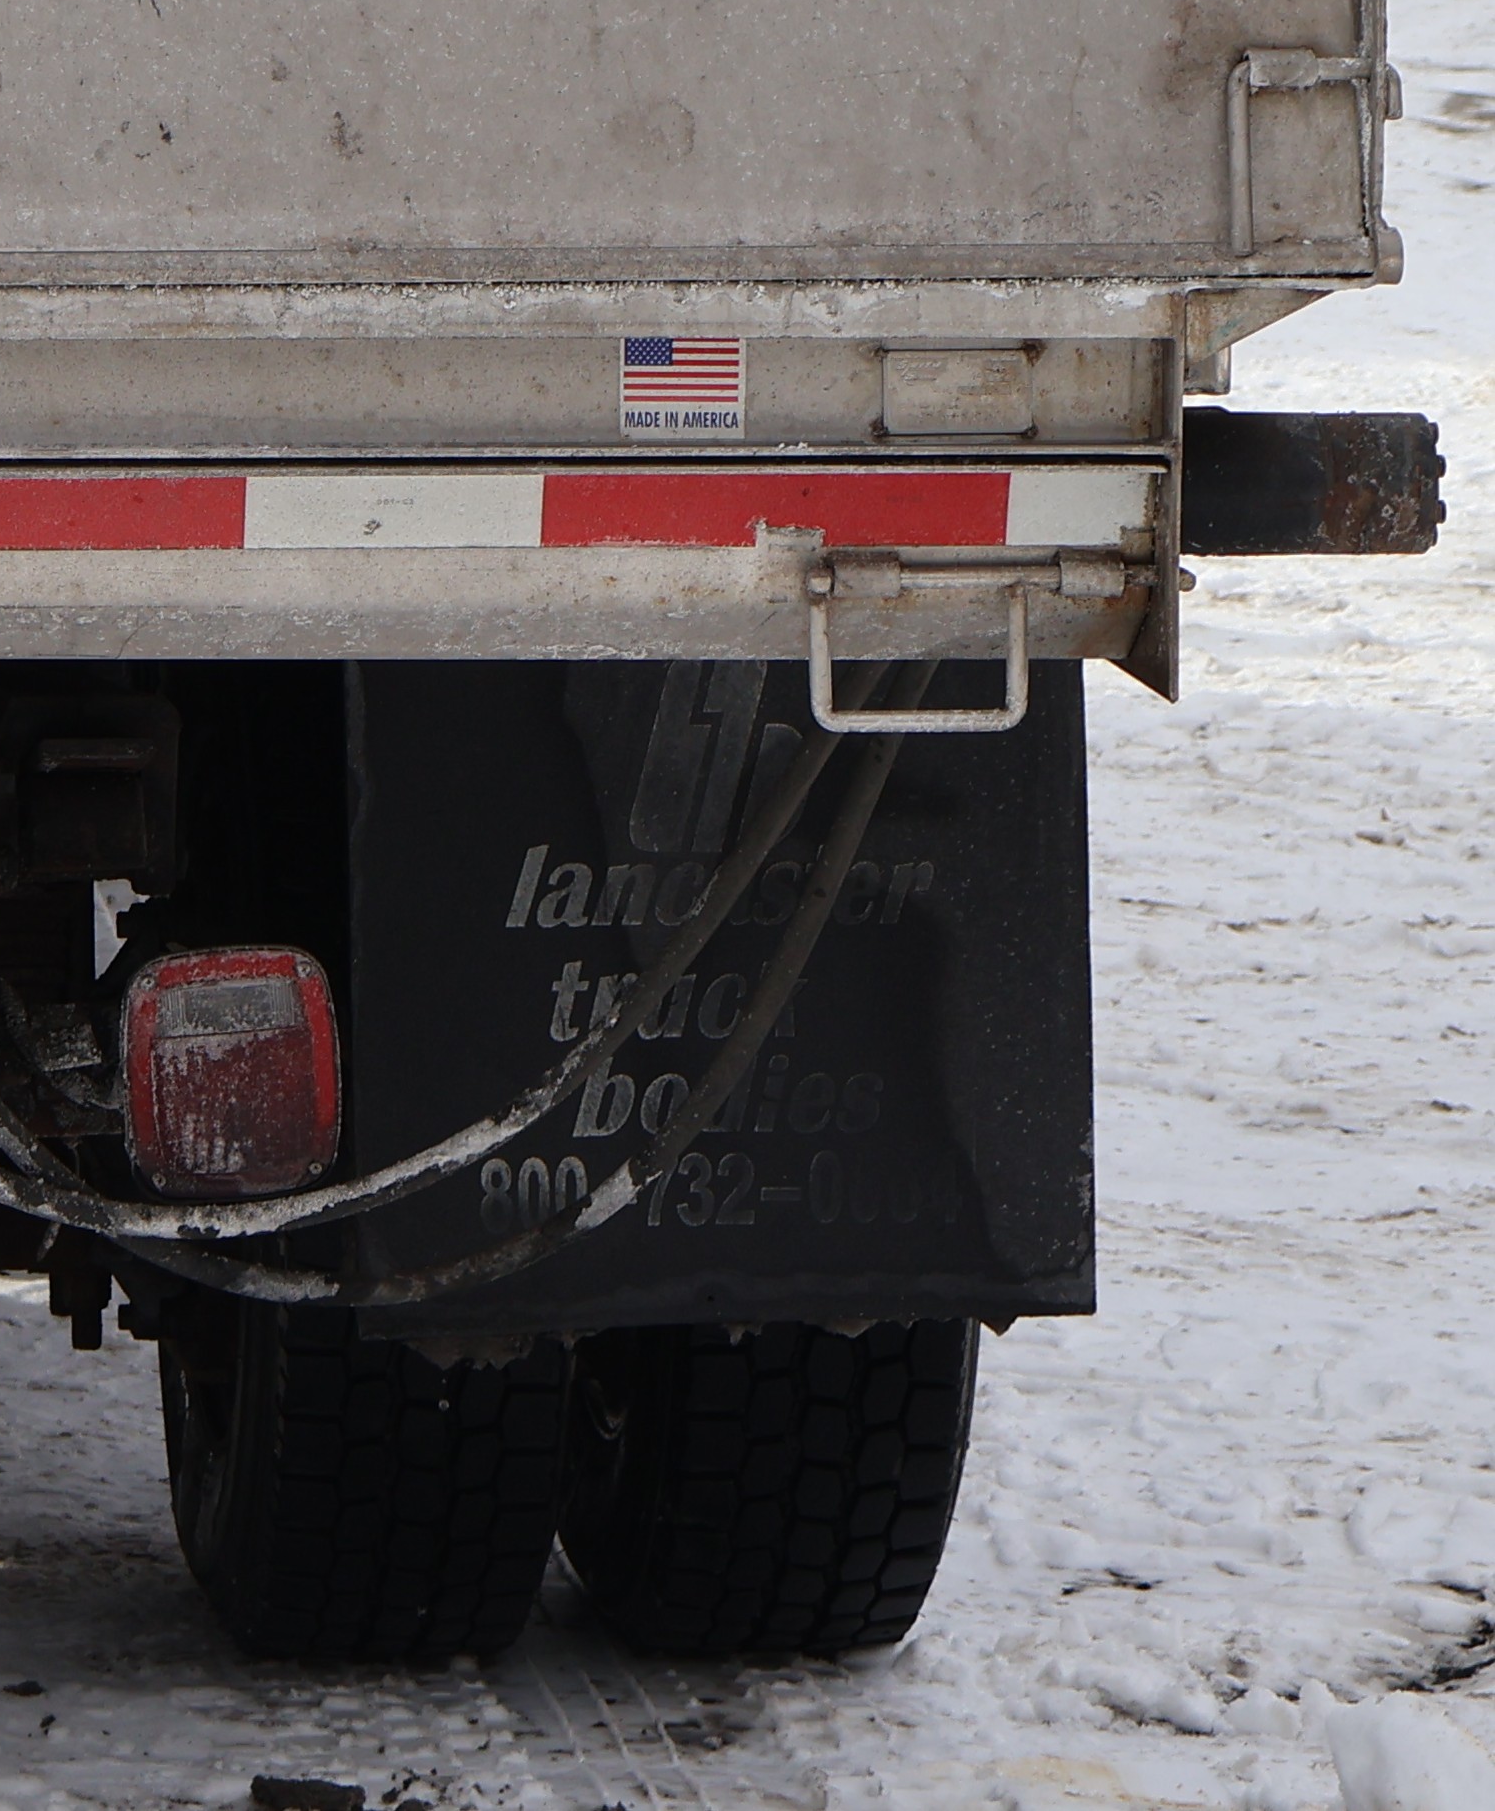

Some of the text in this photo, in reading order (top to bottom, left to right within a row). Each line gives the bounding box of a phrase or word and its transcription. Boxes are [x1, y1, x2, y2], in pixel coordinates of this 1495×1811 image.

[624, 411, 739, 428] MADE IN AMERICA
